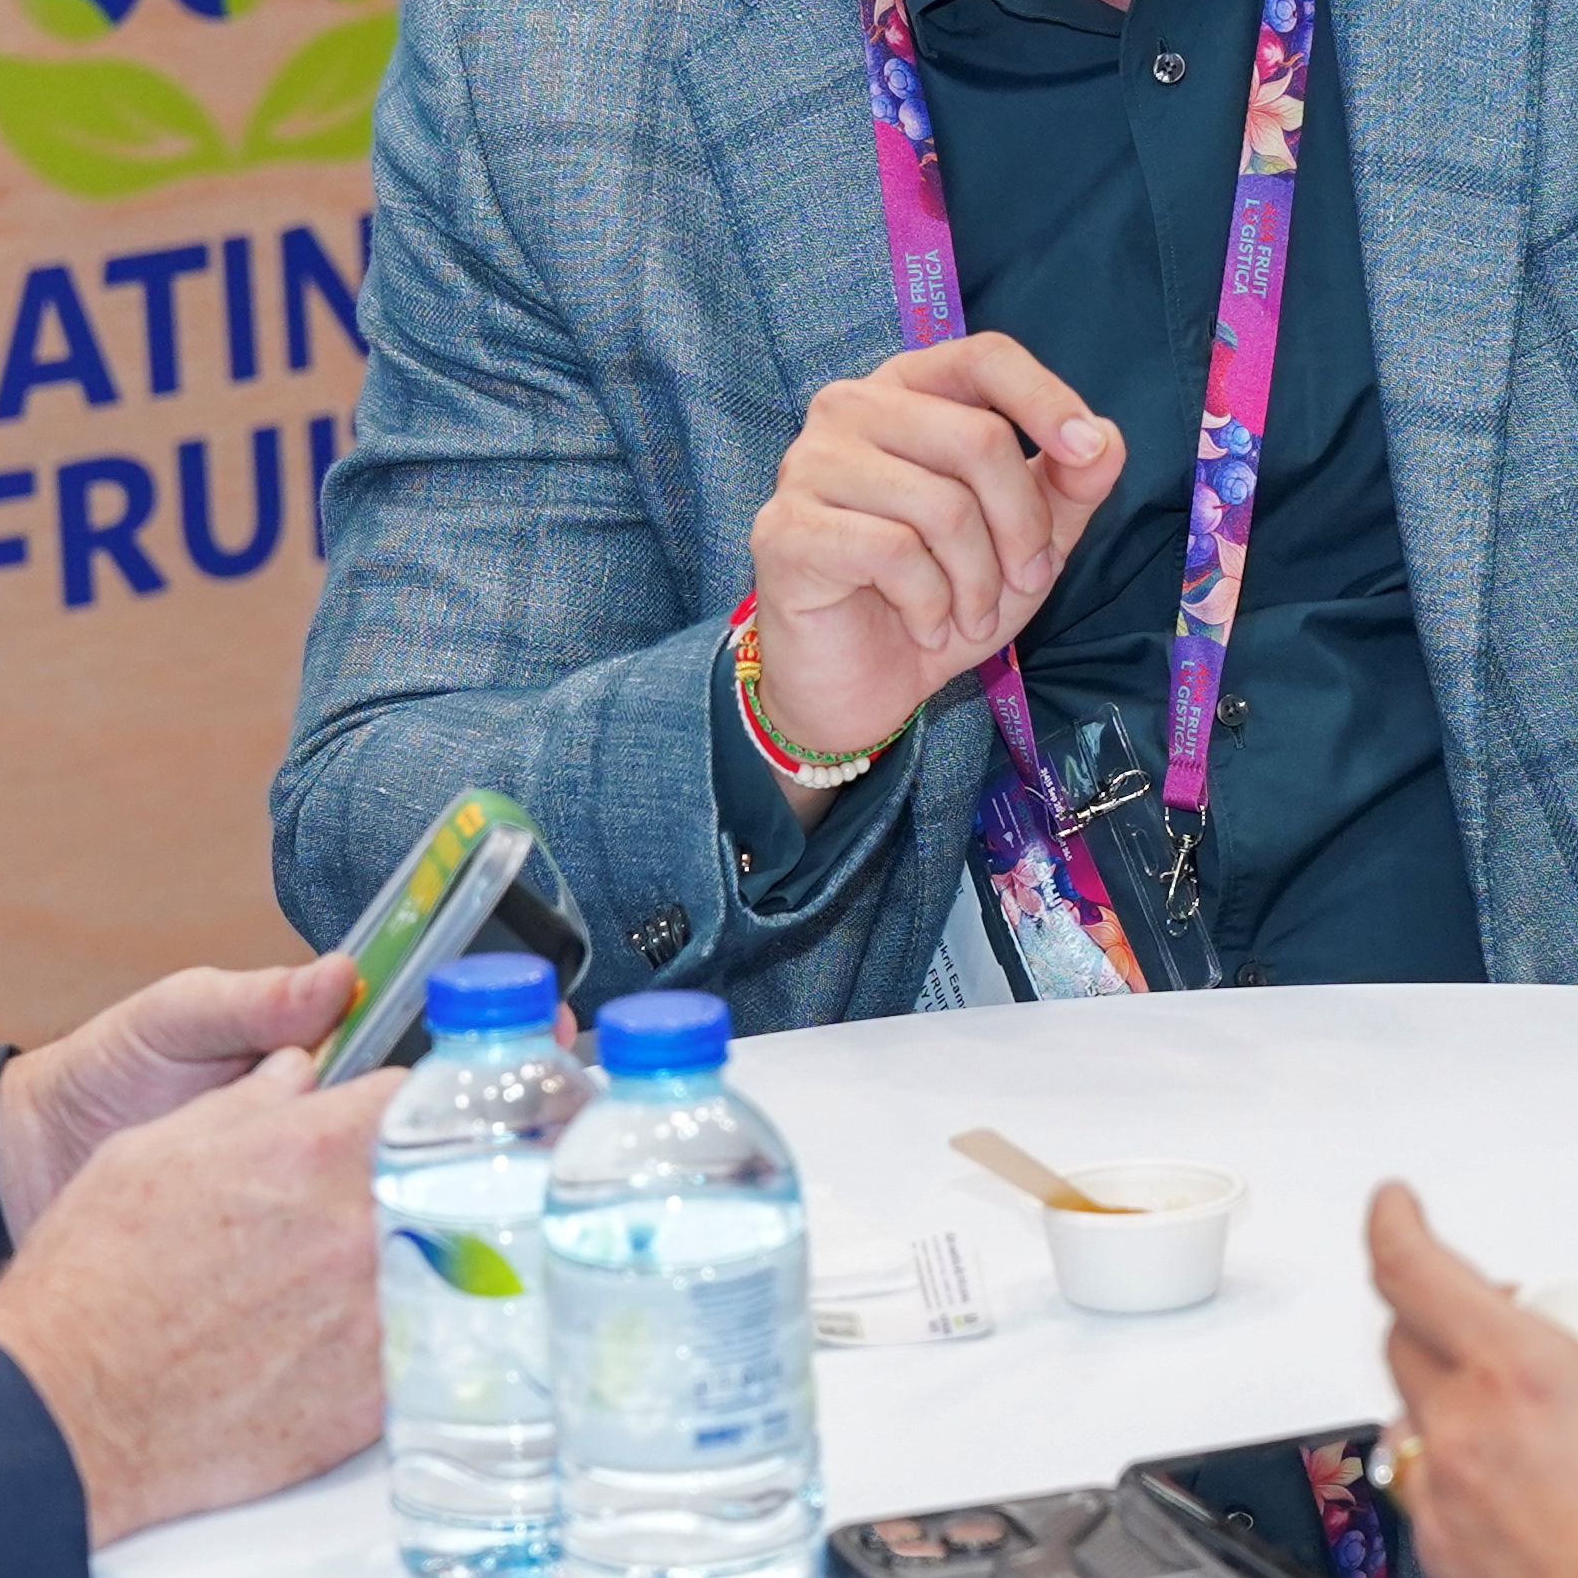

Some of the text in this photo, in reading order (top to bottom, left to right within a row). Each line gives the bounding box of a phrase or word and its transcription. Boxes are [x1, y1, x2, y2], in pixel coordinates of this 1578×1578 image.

[1233, 198, 1260, 295] LOGISTICA
[1252, 244, 1272, 300] FRUIT
[905, 251, 928, 304] FRUIT
[1174, 660, 1195, 756] LOGISTICA
[1184, 705, 1202, 759] FRUIT
[938, 938, 954, 972] akrit
